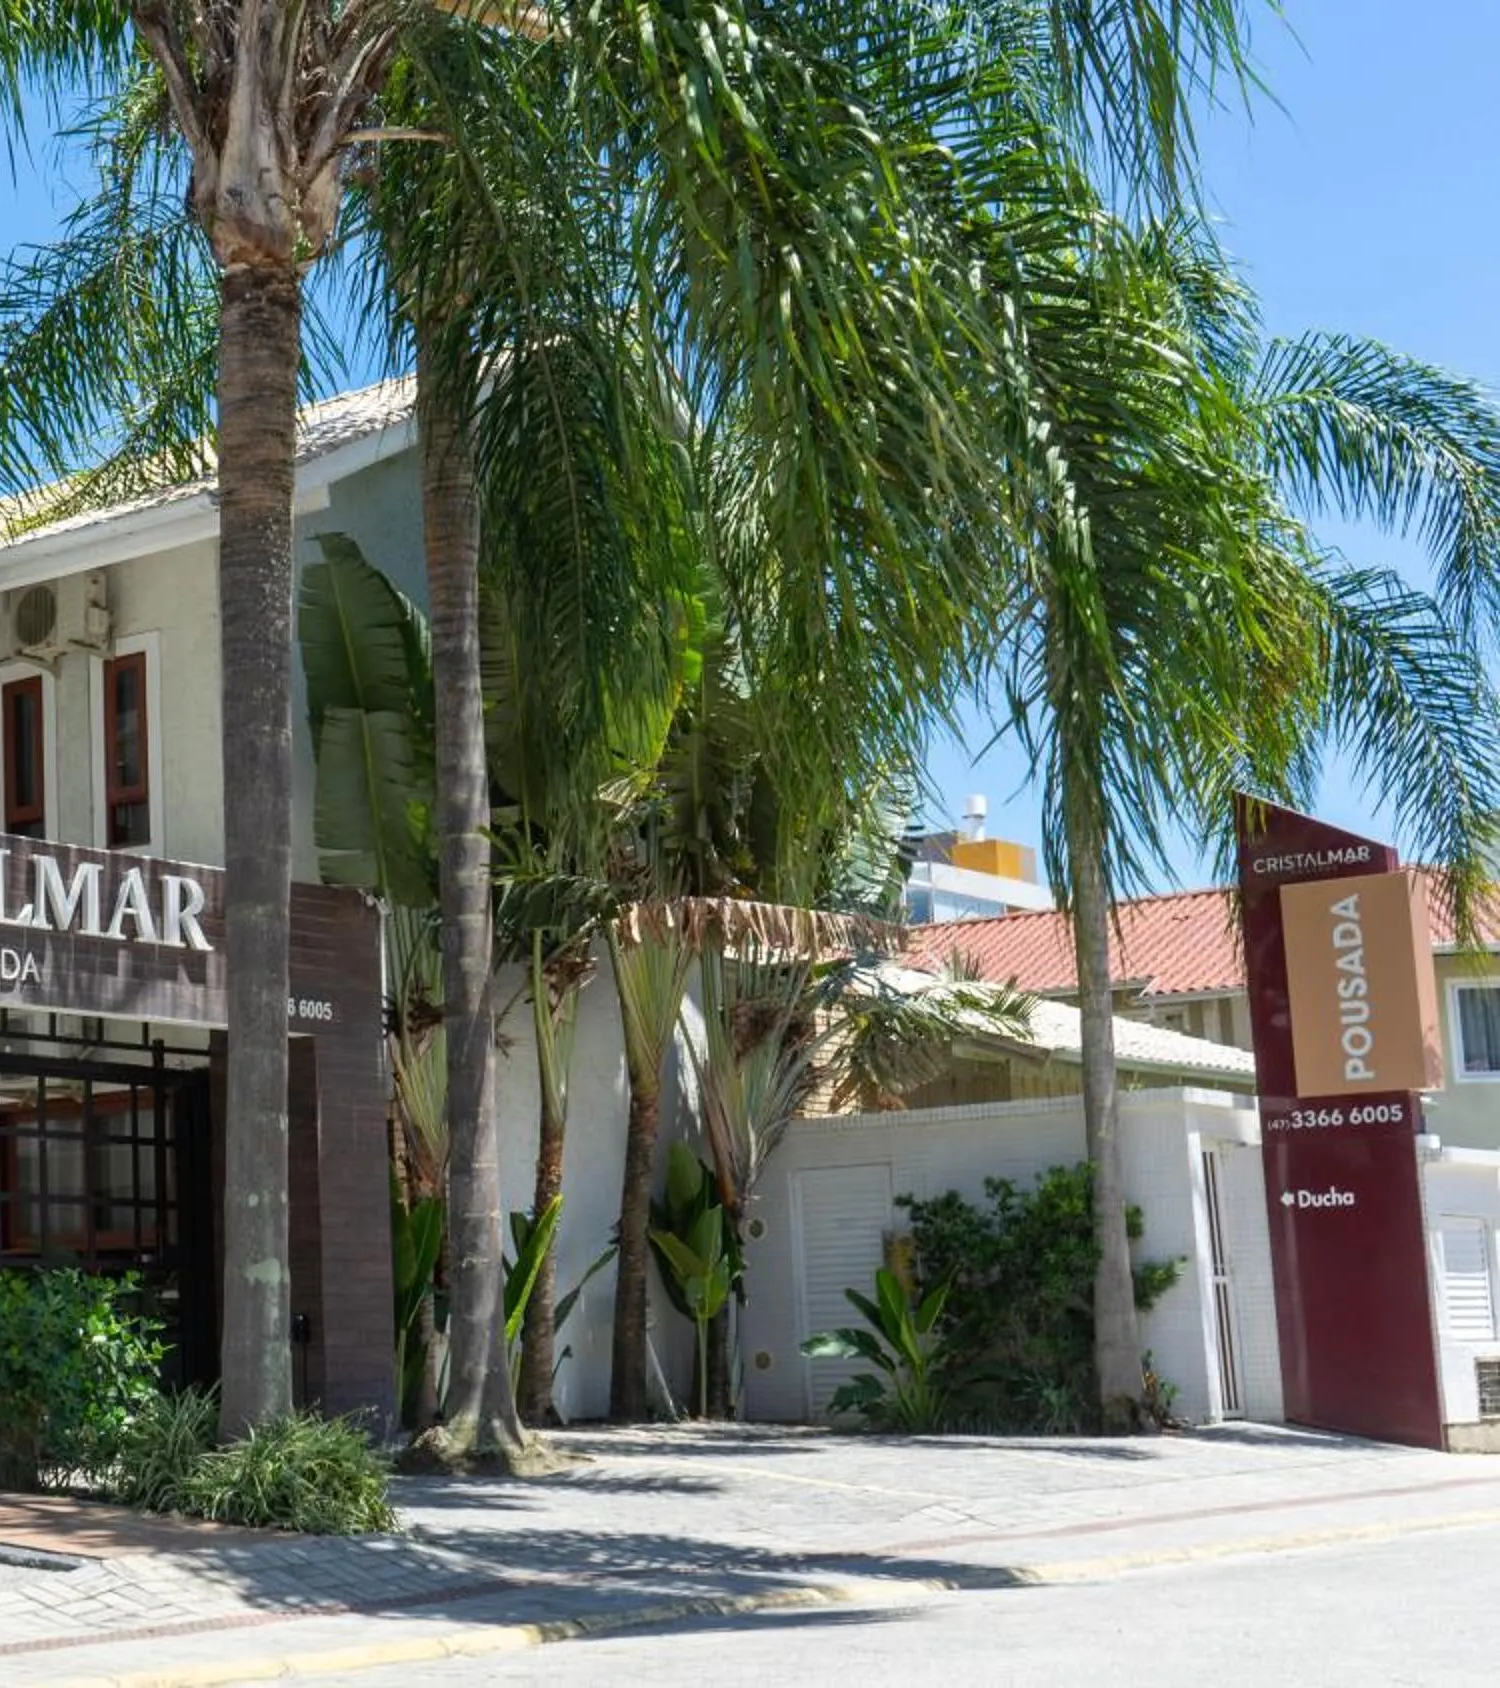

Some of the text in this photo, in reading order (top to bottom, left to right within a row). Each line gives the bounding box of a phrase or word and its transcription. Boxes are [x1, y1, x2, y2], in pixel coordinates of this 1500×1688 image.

[1253, 845, 1371, 873] CRISTALMAR
[1330, 893, 1375, 1082] POUSADA
[299, 1000, 333, 1021] 6005
[1349, 1104, 1403, 1125] 6005
[1297, 1185, 1355, 1208] Ducha
